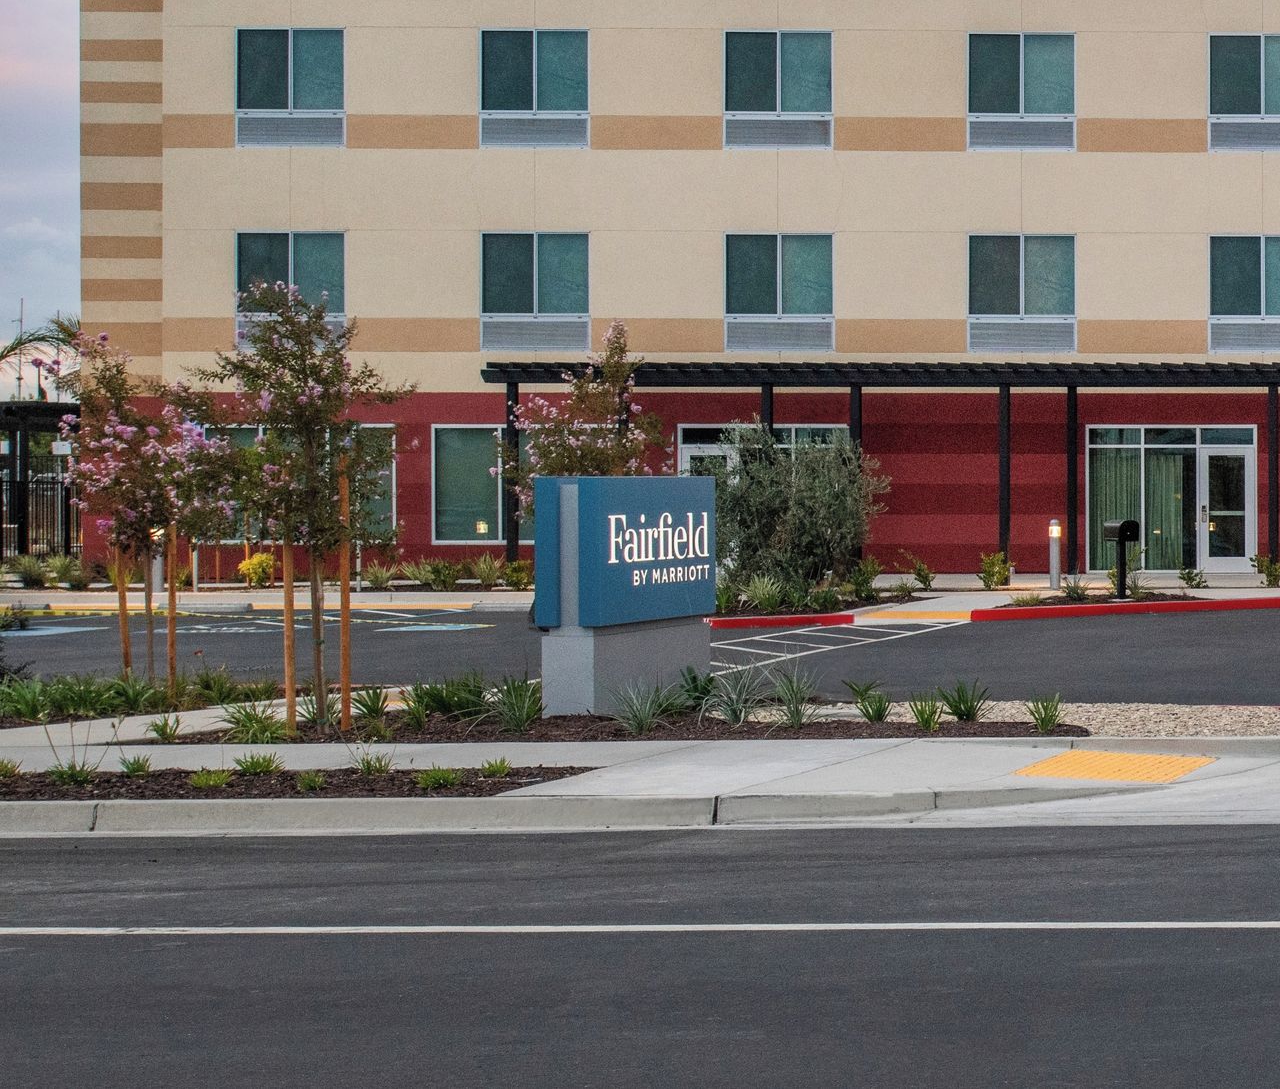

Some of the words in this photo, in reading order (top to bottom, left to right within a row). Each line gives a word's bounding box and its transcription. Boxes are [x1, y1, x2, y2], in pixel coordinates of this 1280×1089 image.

[608, 512, 709, 564] Fairfield
[633, 569, 648, 586] BY
[652, 564, 710, 584] MARRIOTT
